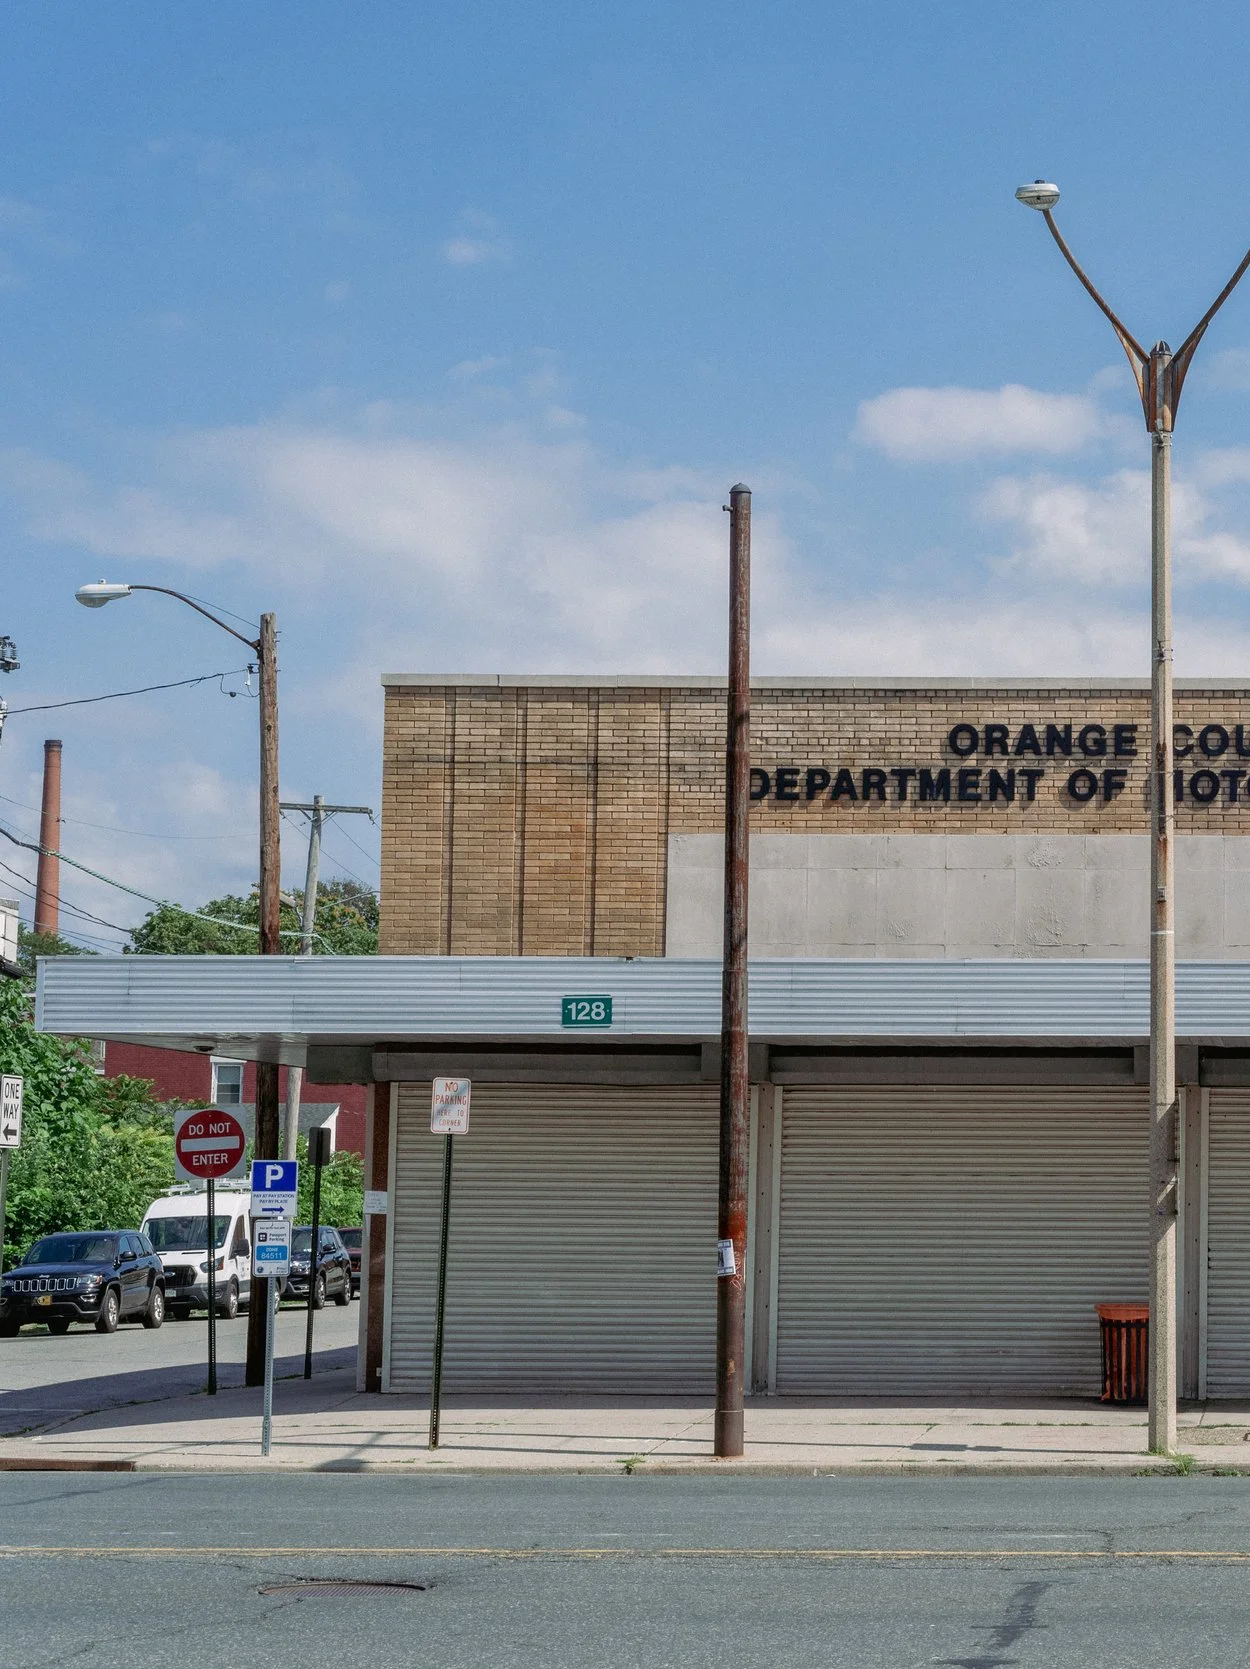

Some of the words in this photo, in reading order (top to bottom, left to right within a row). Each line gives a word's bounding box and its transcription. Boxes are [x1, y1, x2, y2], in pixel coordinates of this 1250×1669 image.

[950, 724, 1138, 756] ORANGE
[750, 768, 1044, 801] DEPARTMENT
[1068, 769, 1127, 802] OF
[568, 1002, 606, 1020] 128
[5, 1082, 20, 1099] ONE
[445, 1082, 458, 1092] NO
[436, 1094, 466, 1106] PARKING
[4, 1103, 19, 1119] WAY
[189, 1124, 204, 1136] DO
[210, 1122, 230, 1134] NOT
[192, 1153, 228, 1166] ENTER
[266, 1164, 284, 1188] P
